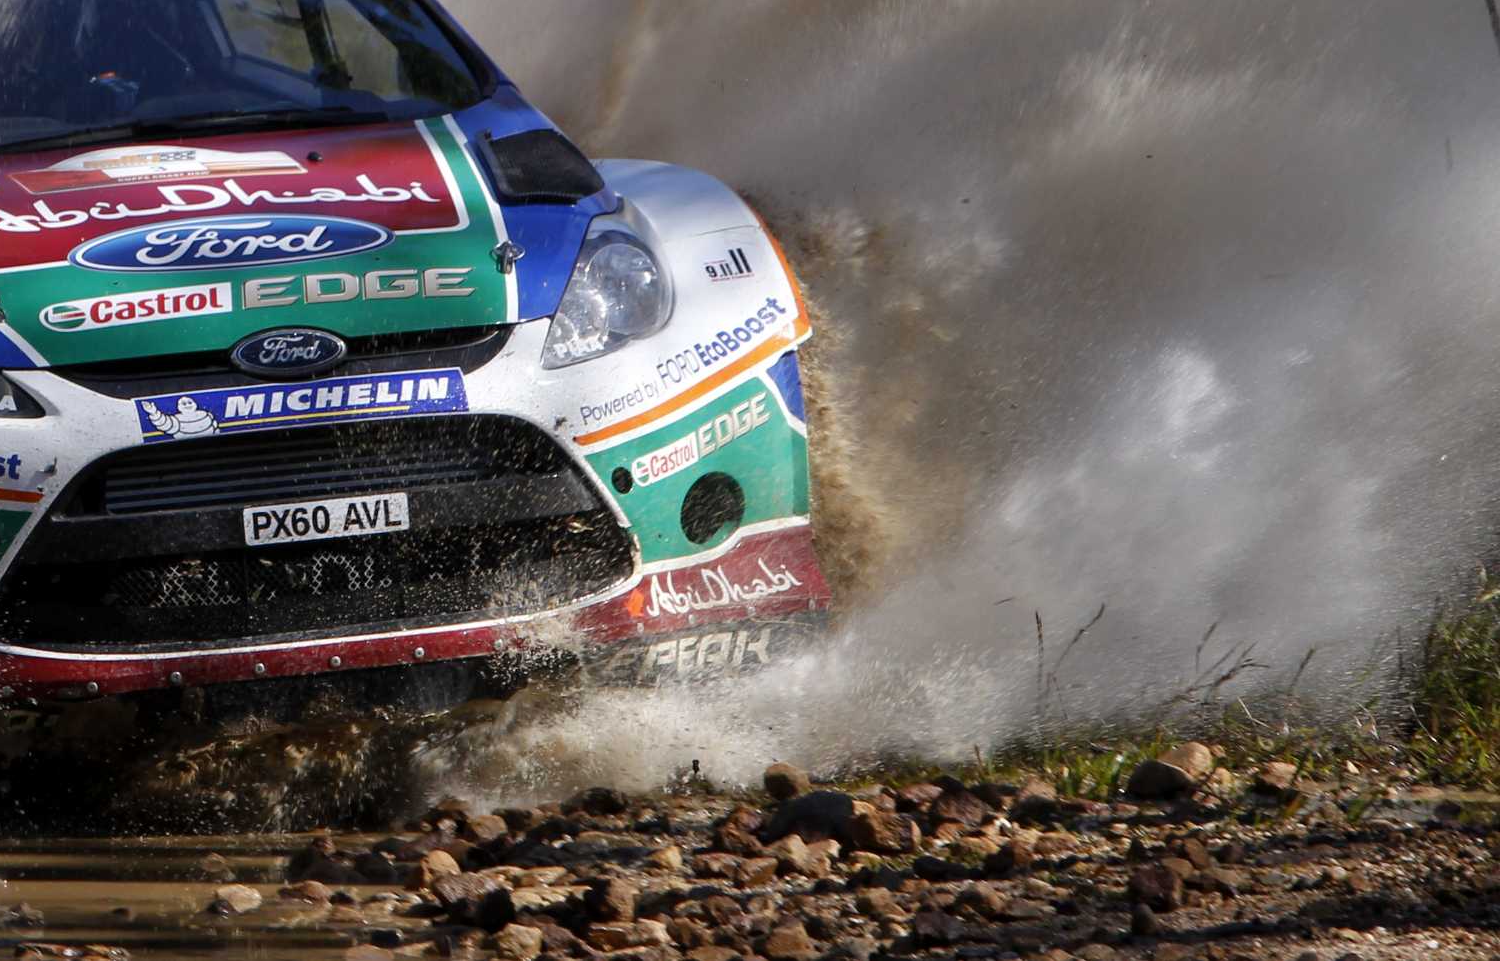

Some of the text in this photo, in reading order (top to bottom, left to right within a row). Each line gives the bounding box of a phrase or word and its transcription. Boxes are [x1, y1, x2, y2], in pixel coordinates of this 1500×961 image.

[157, 173, 441, 211] Dhabi
[135, 222, 334, 266] Ford
[89, 267, 476, 325] Castrol EDGE
[258, 333, 321, 363] Ford
[580, 387, 644, 426] Powered
[644, 378, 660, 399] by
[693, 297, 786, 367] EcoBoost
[224, 377, 450, 418] MICHELIN
[650, 391, 771, 479] Castrol EDGE
[252, 499, 402, 540] PX60 AVL
